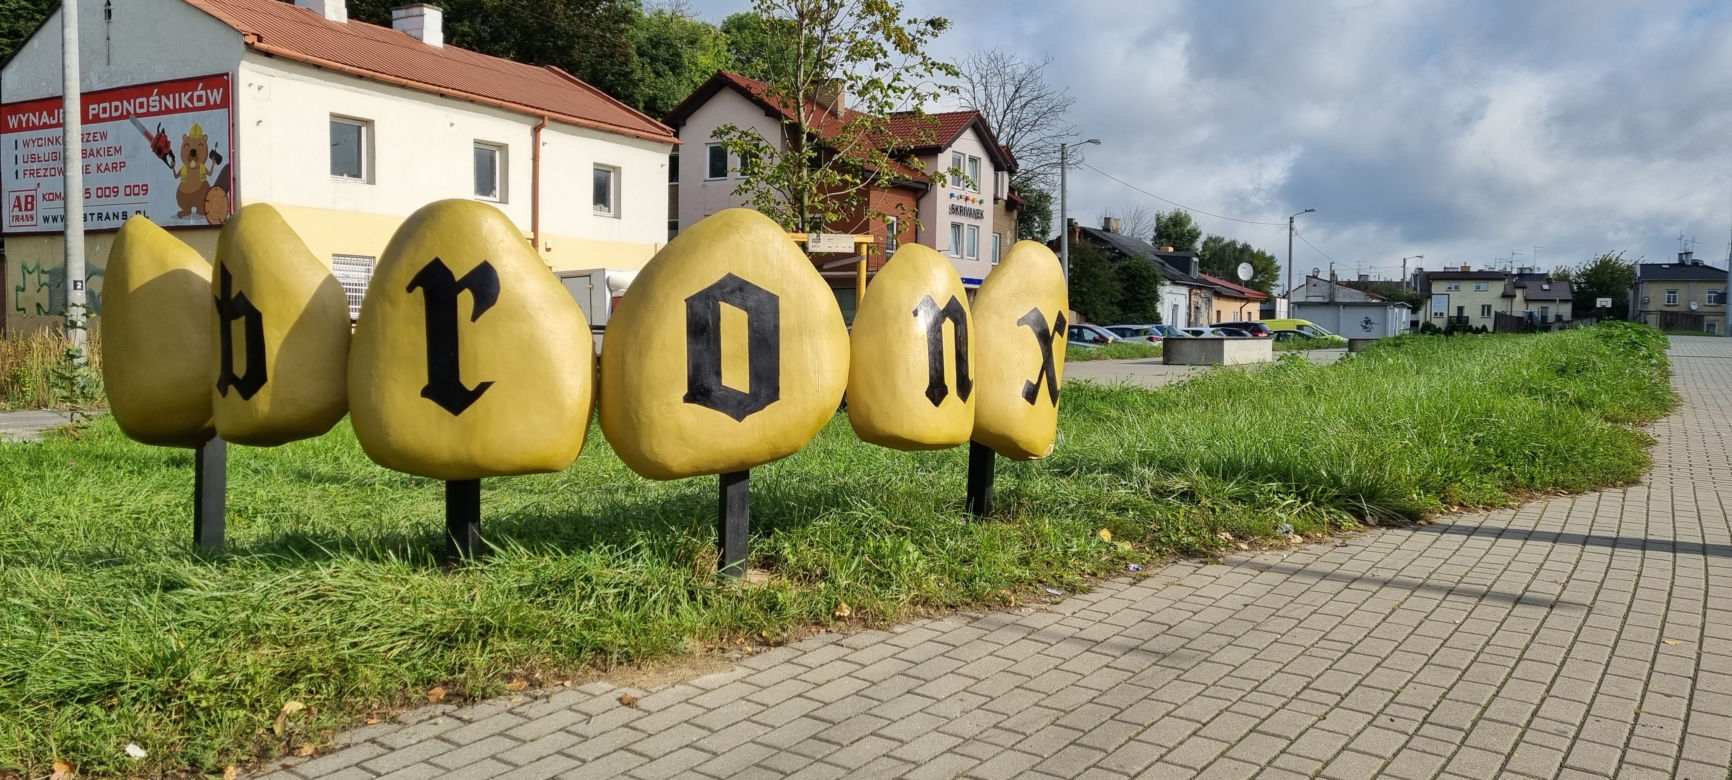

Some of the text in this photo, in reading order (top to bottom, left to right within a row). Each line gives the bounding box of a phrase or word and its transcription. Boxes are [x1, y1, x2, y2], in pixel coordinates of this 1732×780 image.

[8, 83, 223, 129] WYNAJE PODNOŚNIKÓW
[22, 130, 108, 149] WYCINK RZEW
[22, 145, 122, 164] USŁUGI BAKIEM
[23, 161, 126, 179] FREZOWIE KARP
[96, 186, 119, 199] 009
[124, 183, 149, 197] 009
[11, 194, 35, 213] AB
[11, 214, 35, 223] TRANS
